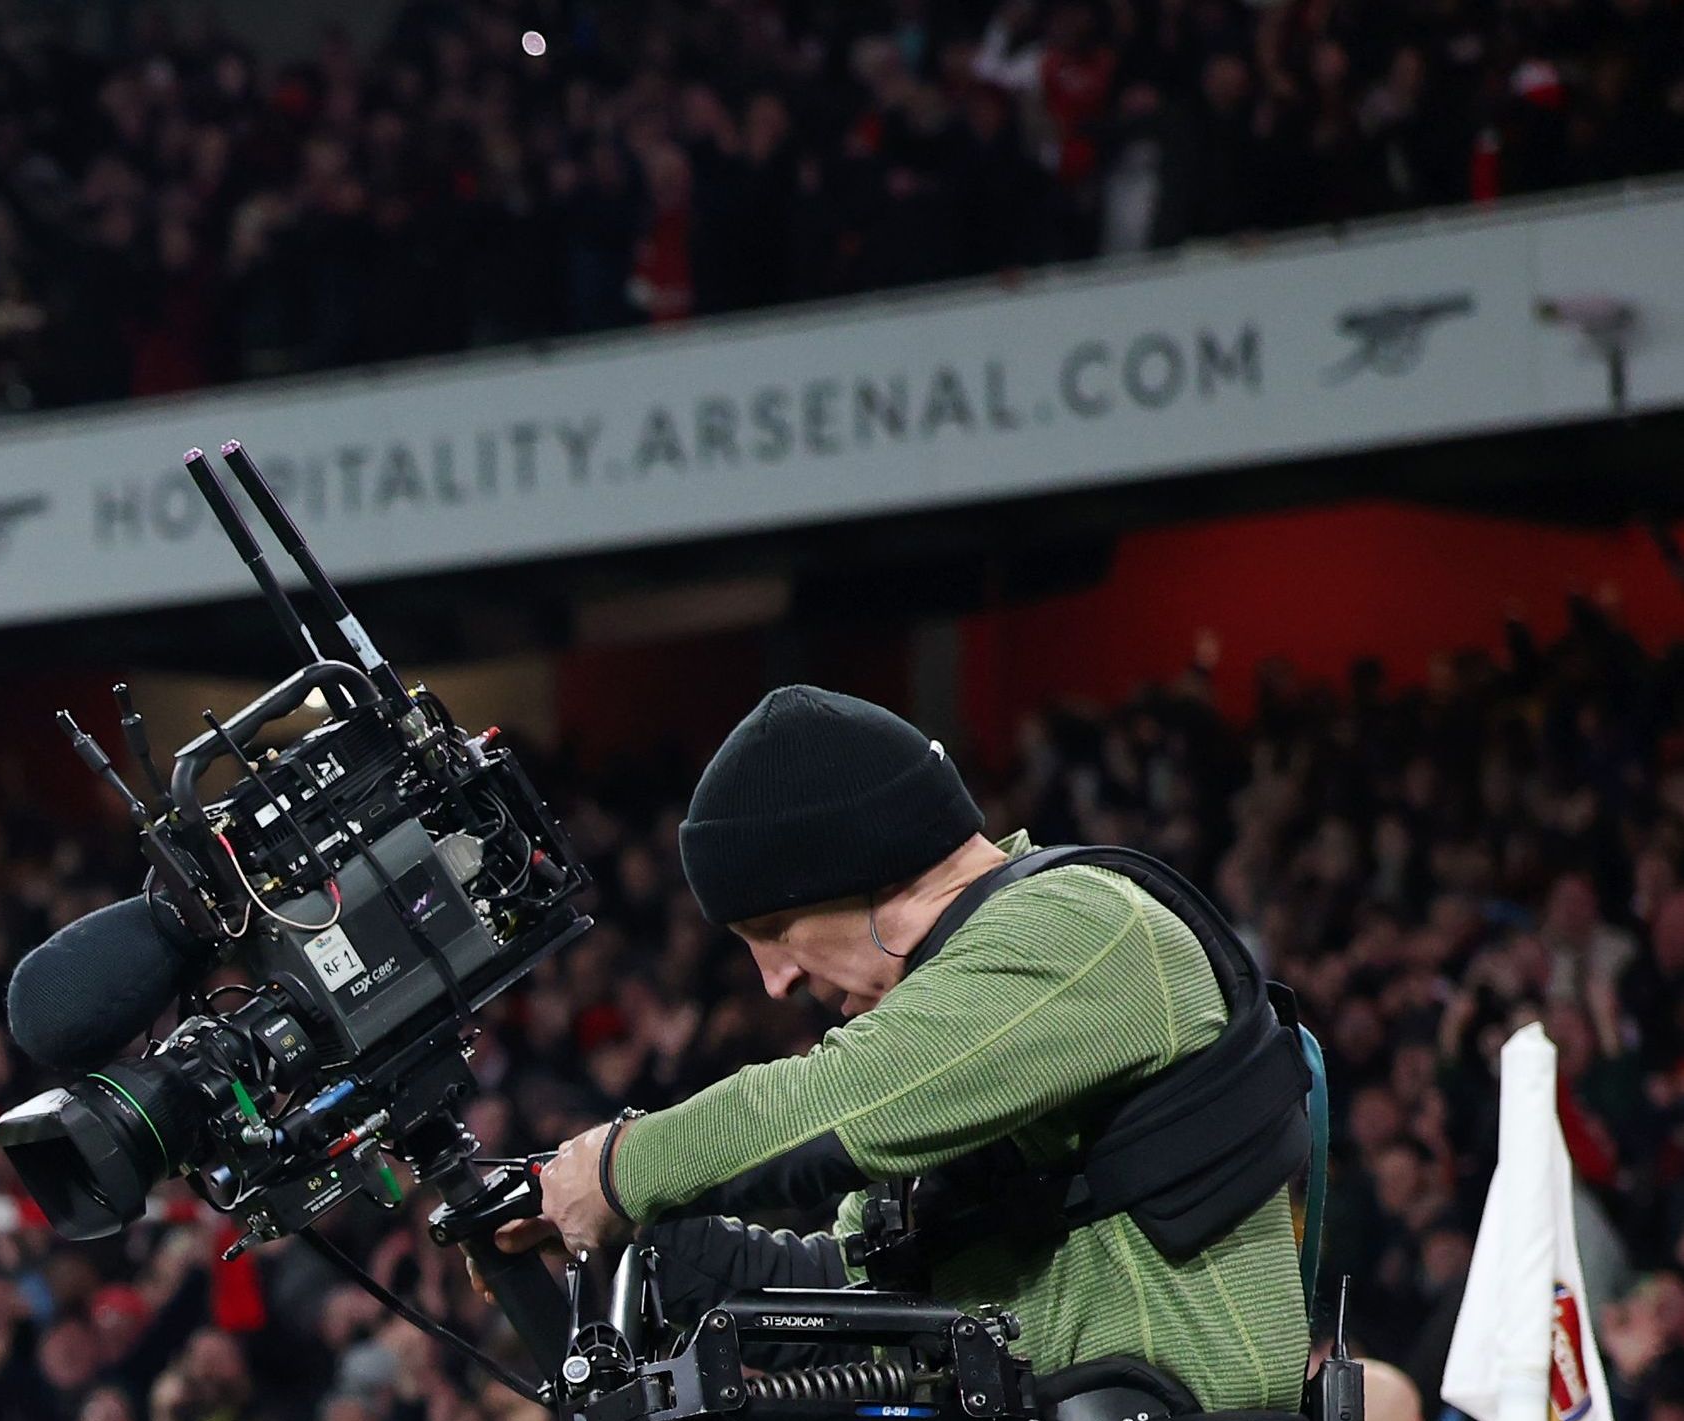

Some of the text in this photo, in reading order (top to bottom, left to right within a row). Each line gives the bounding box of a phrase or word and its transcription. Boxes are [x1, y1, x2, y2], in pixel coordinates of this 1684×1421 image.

[323, 956, 342, 976] RF
[761, 1315, 825, 1327] STEADICAM
[882, 1406, 909, 1416] G-50
